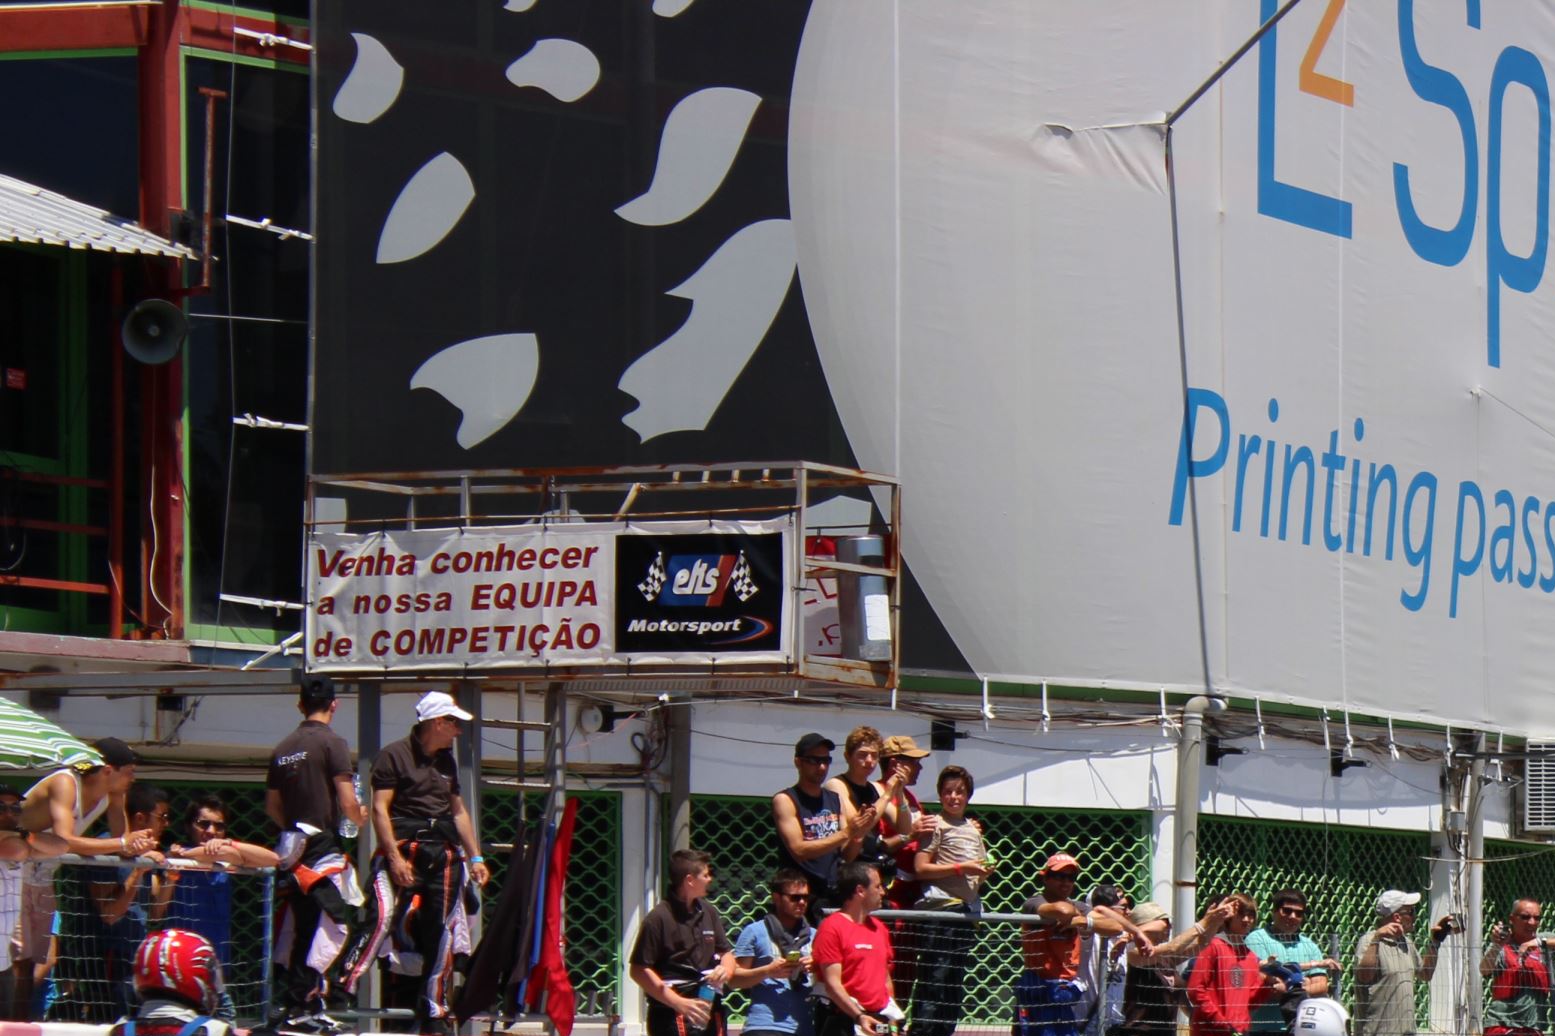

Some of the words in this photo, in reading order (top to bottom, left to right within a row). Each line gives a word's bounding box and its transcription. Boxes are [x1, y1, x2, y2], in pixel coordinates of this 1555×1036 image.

[1168, 387, 1438, 612] Printing
[317, 547, 417, 578] Venha
[430, 543, 600, 574] conhecer
[316, 596, 335, 615] a
[353, 591, 453, 615] nossa
[470, 580, 599, 611] EQUIPA
[314, 632, 353, 657] de
[369, 618, 601, 658] COMPETIÇÃO
[627, 618, 742, 635] Motorsport
